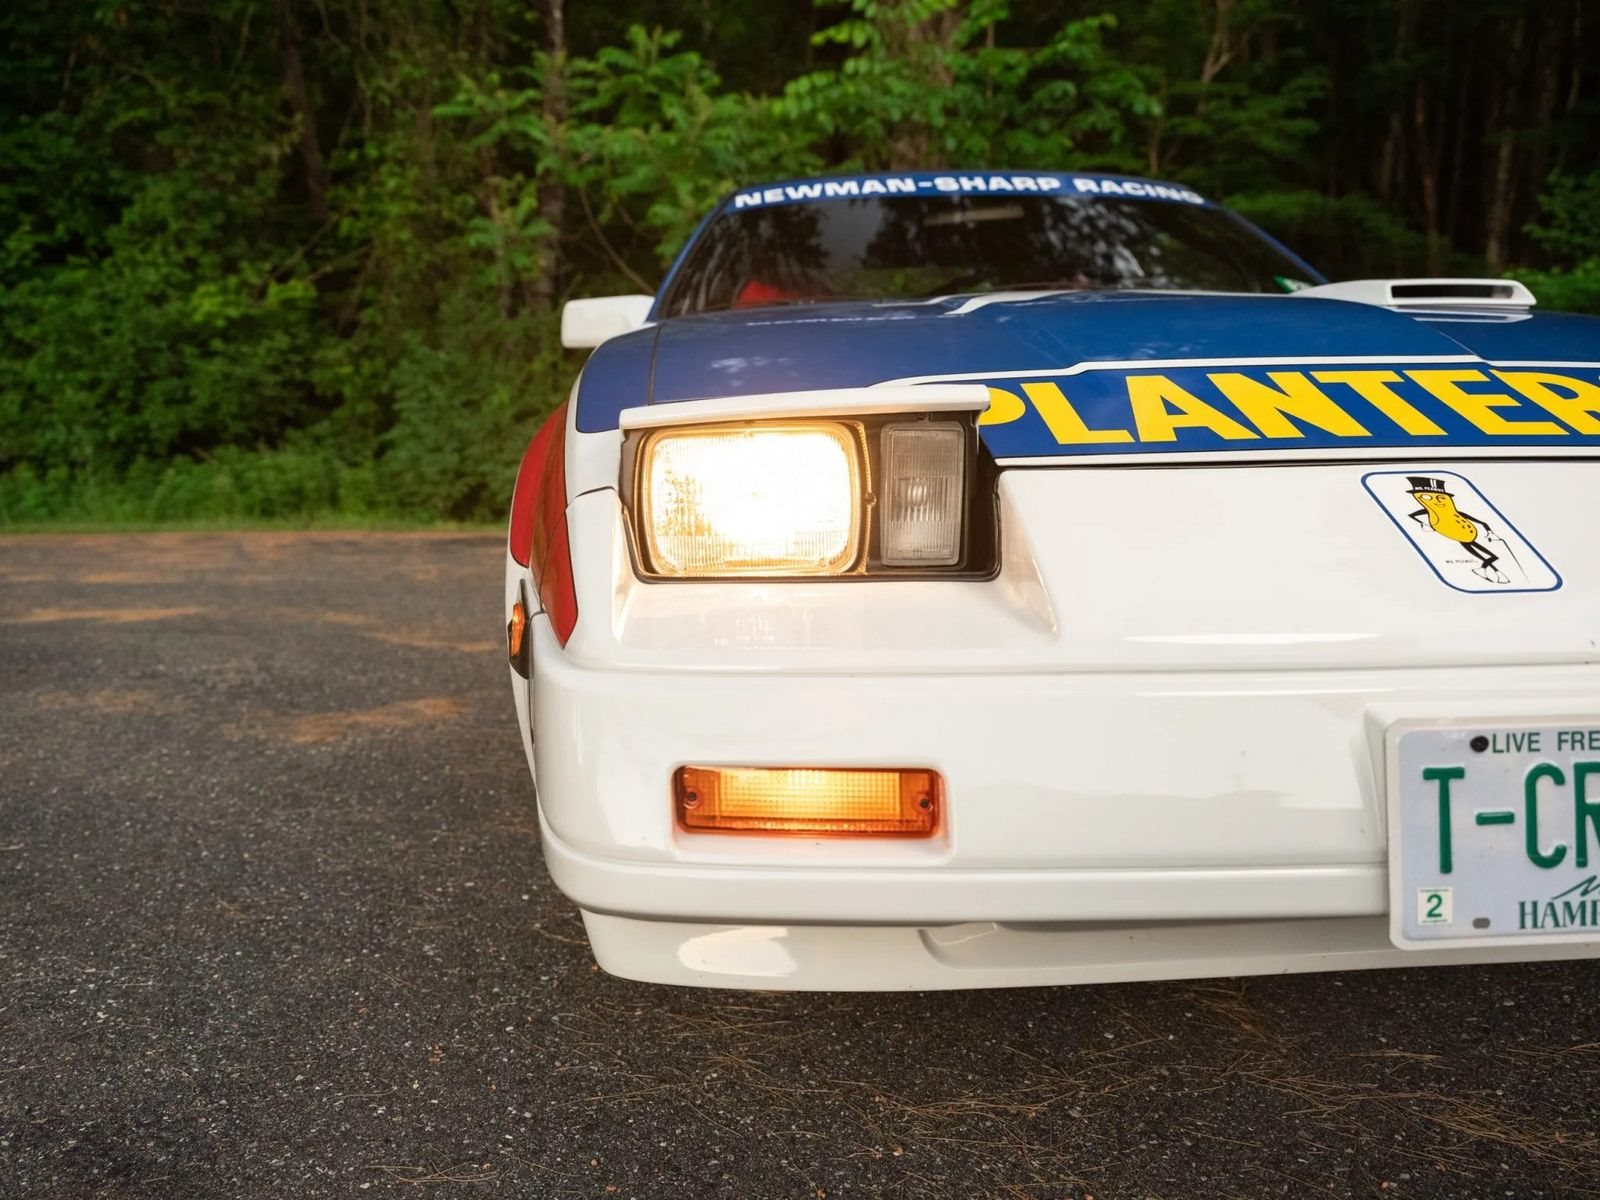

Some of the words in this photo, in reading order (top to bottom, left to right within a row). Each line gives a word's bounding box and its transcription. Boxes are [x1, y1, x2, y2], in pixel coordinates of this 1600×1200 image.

[735, 176, 1060, 209] NEWMAN-SHARP
[1072, 177, 1205, 205] RACING
[1492, 732, 1541, 753] LIVE
[1557, 730, 1600, 752] FRE
[1422, 761, 1600, 875] T-CR
[1426, 893, 1443, 918] 2
